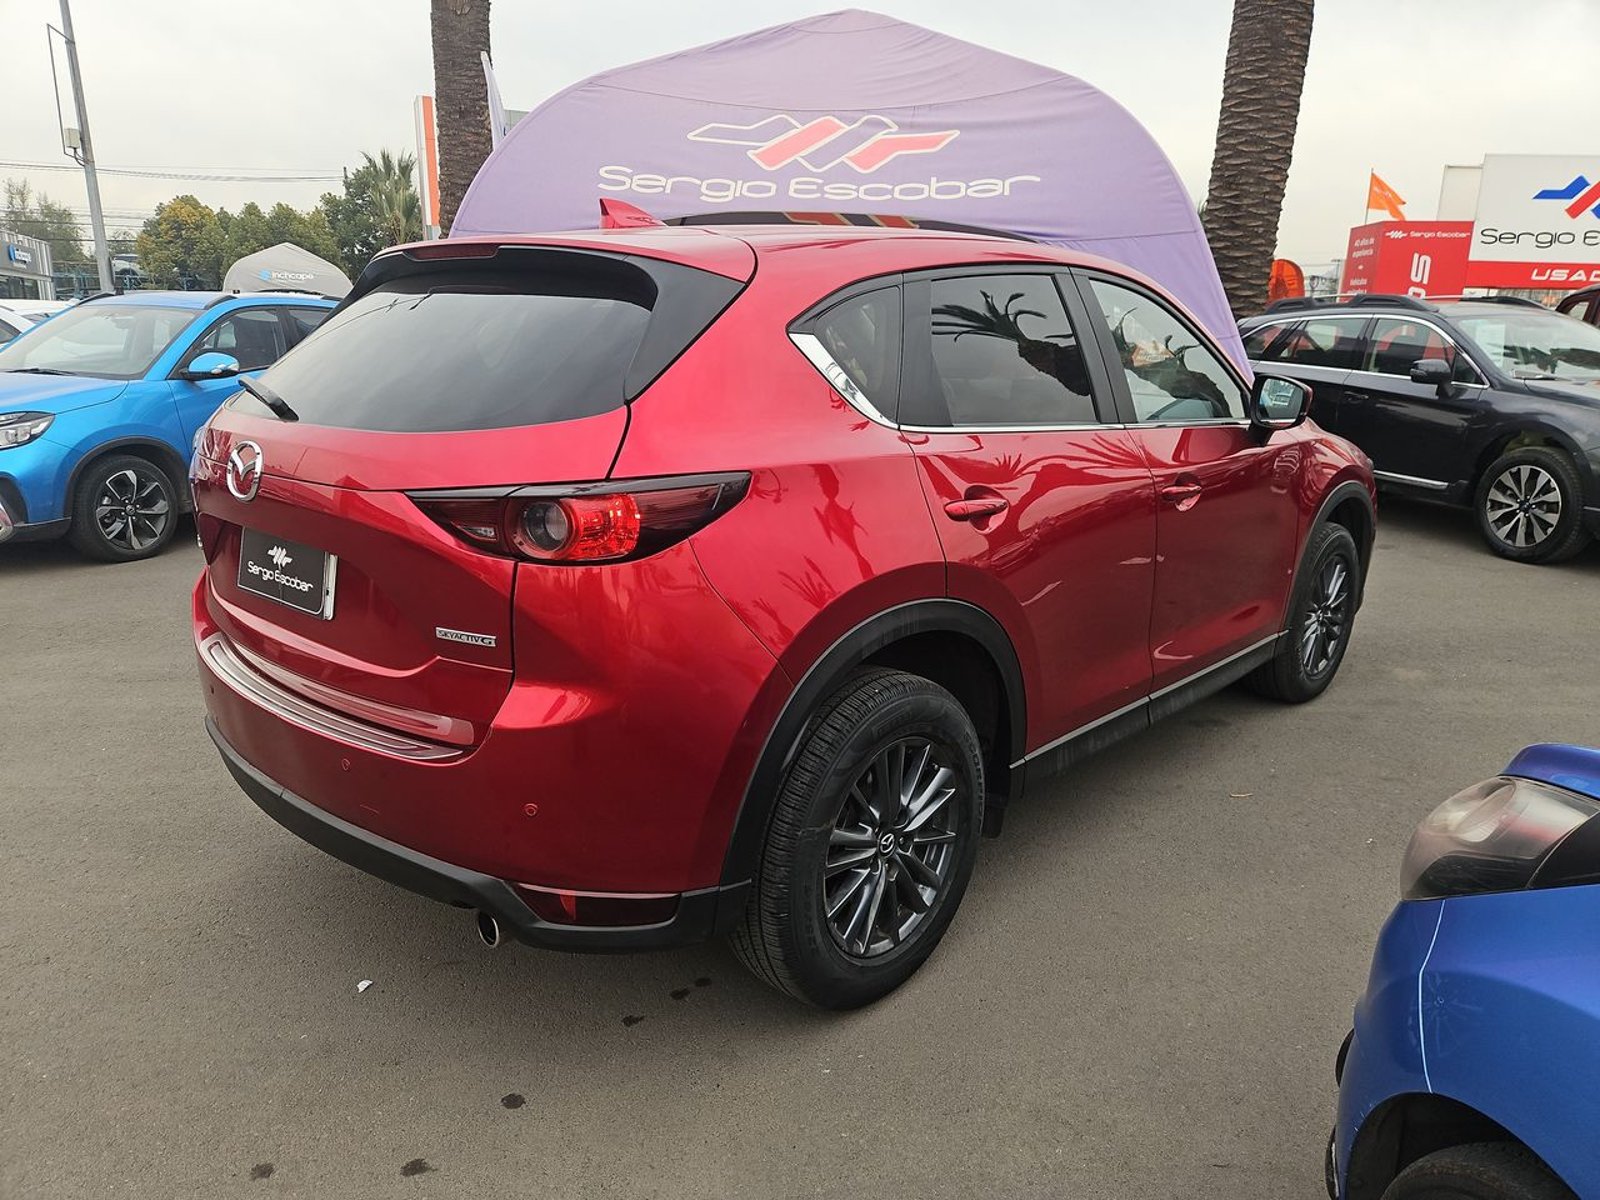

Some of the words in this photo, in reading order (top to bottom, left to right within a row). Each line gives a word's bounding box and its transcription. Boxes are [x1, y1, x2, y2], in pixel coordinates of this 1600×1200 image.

[597, 165, 776, 203] Sergio
[788, 175, 1041, 201] Escobar
[1480, 228, 1576, 249] Sergio
[274, 569, 314, 592] Escobar
